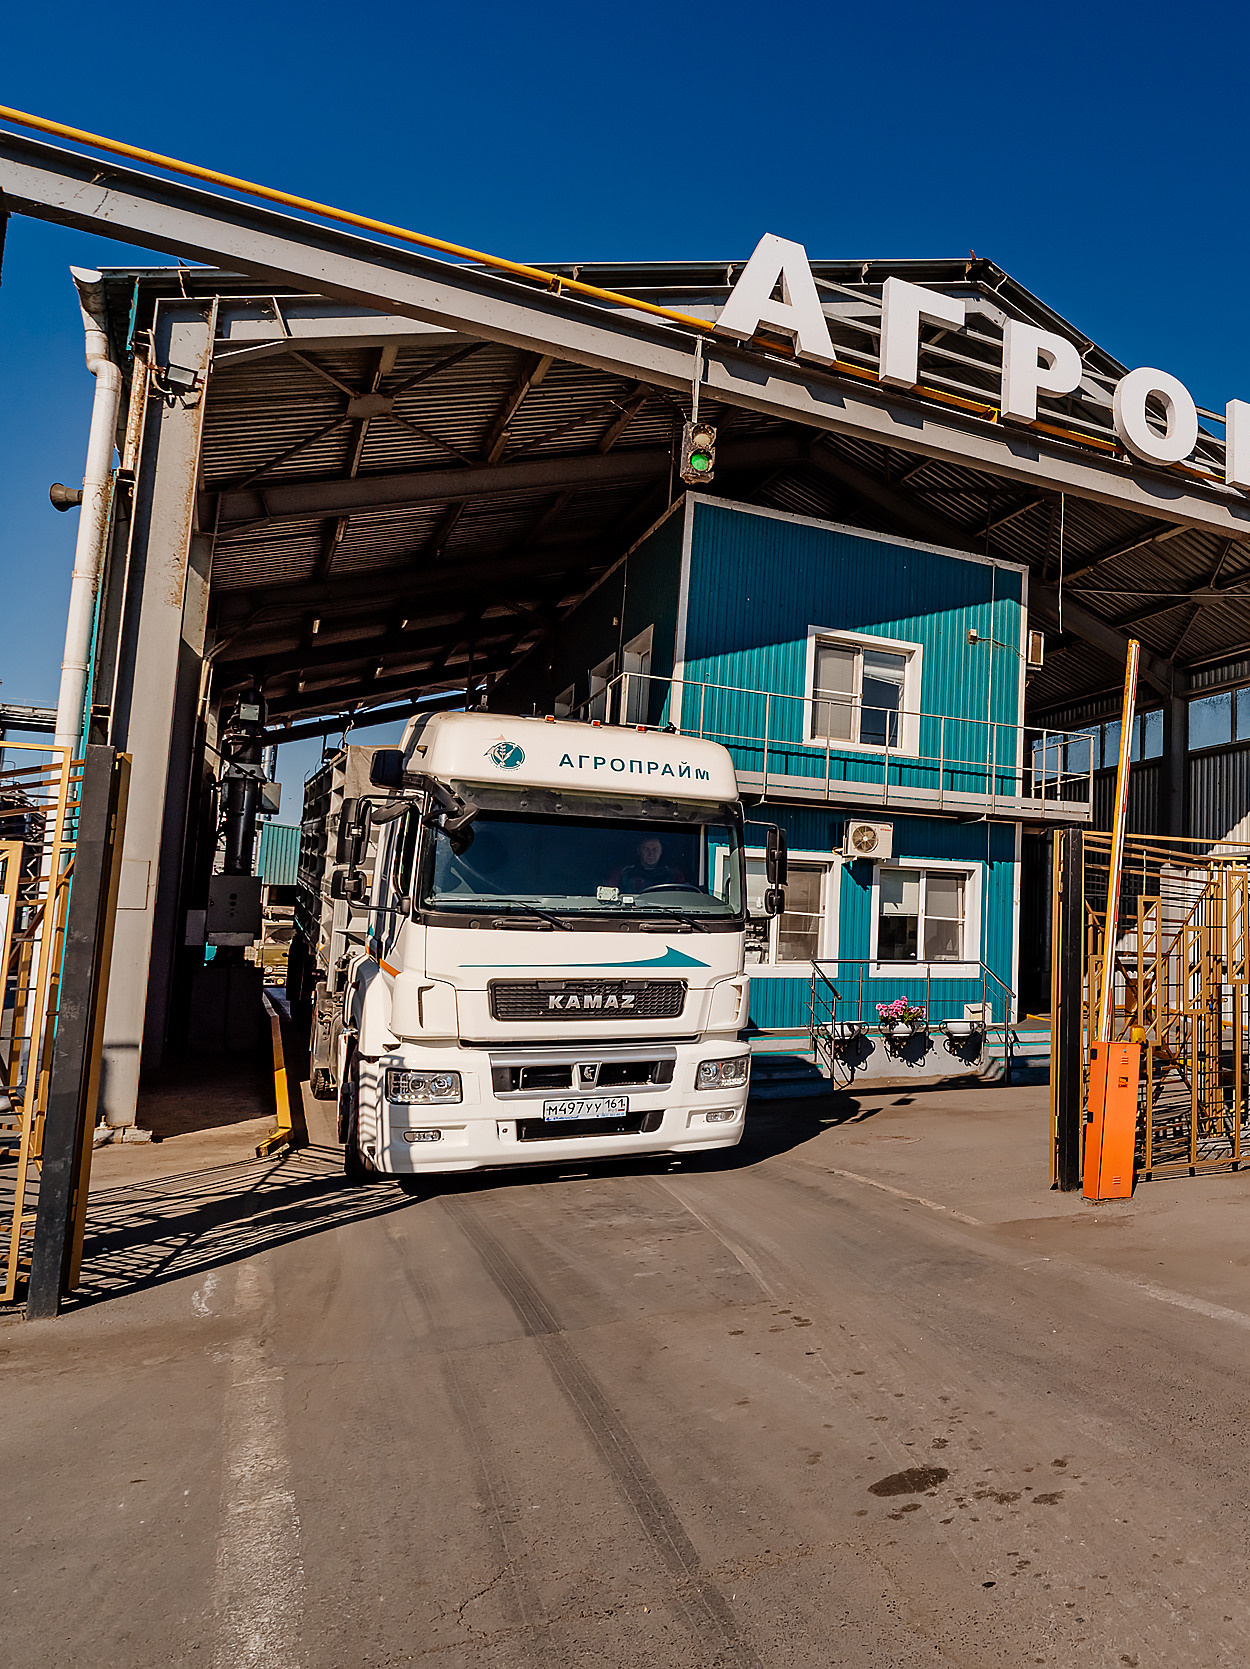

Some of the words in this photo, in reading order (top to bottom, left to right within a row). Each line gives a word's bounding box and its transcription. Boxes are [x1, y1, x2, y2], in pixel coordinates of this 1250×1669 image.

[559, 753, 710, 781] АГРОПРАЙМ
[548, 995, 636, 1009] KAMAZ
[605, 1098, 624, 1109] 161
